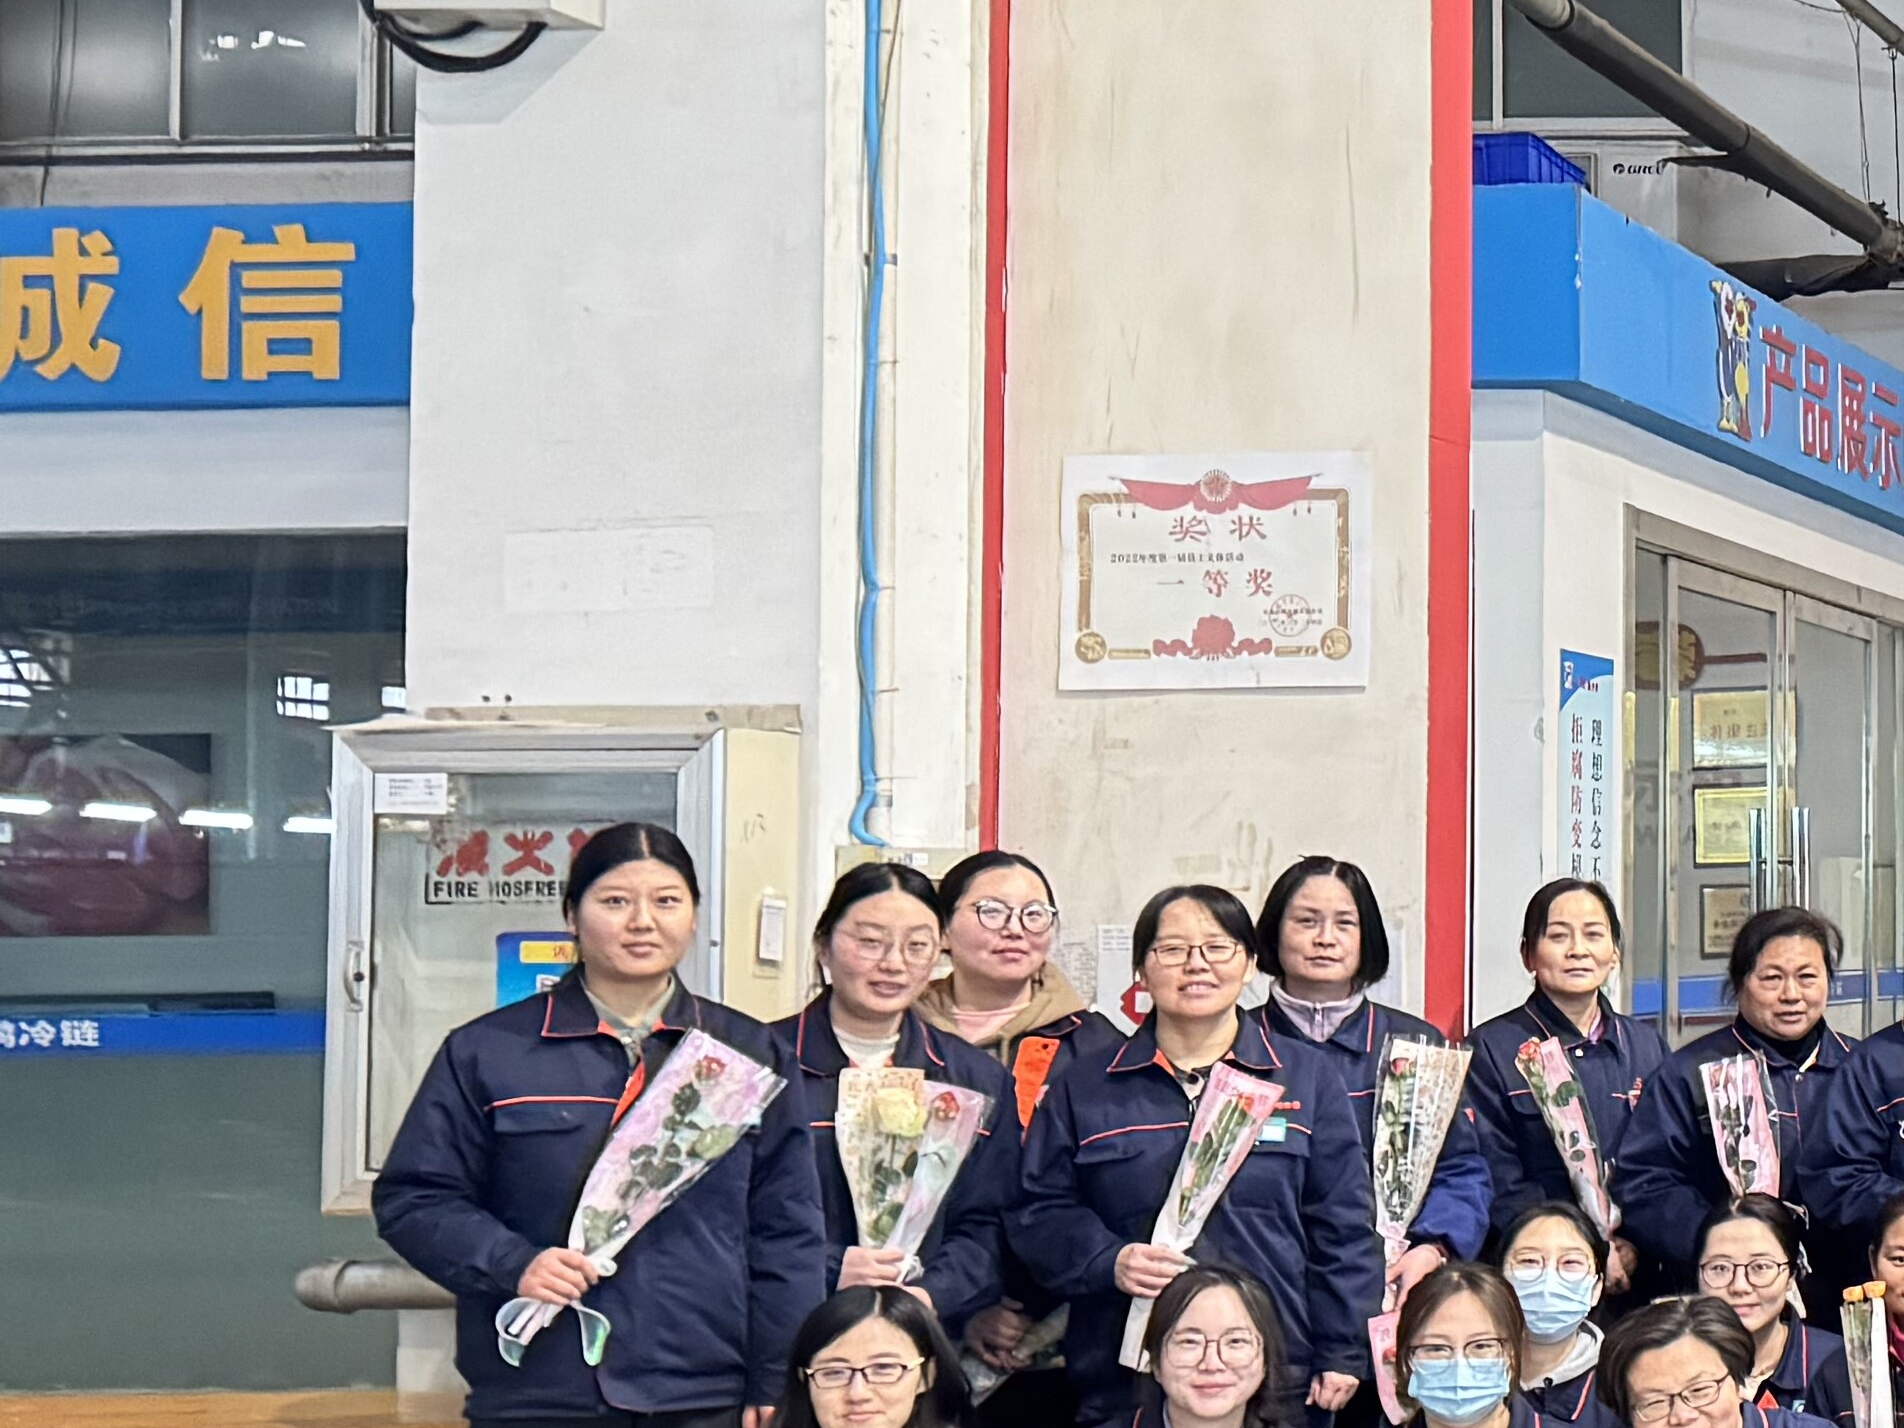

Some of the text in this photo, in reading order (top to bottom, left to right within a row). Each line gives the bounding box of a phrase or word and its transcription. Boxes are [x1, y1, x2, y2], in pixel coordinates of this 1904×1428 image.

[1168, 515, 1267, 542] 奖状
[1156, 568, 1274, 598] 一等奖
[433, 881, 479, 898] FIRE
